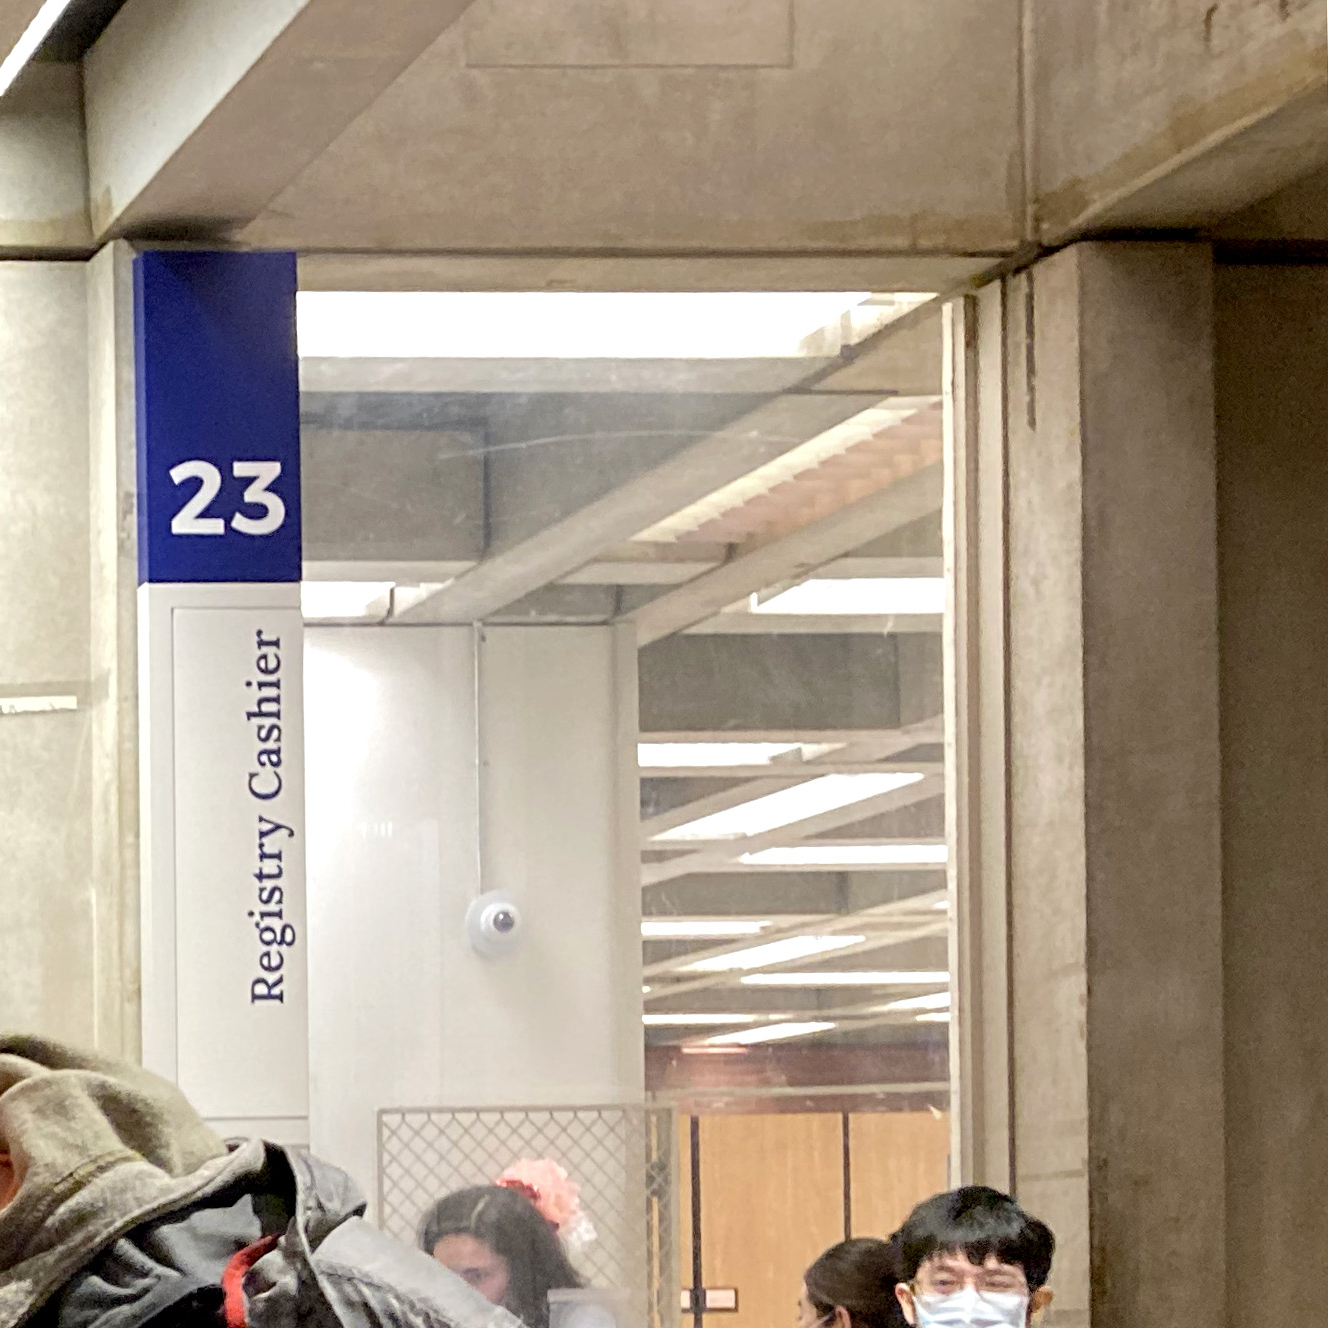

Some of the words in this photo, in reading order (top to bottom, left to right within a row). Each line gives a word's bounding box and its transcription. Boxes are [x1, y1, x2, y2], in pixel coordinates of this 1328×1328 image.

[169, 460, 286, 535] 23
[245, 628, 282, 801] Cashier
[248, 814, 296, 1005] Registry
